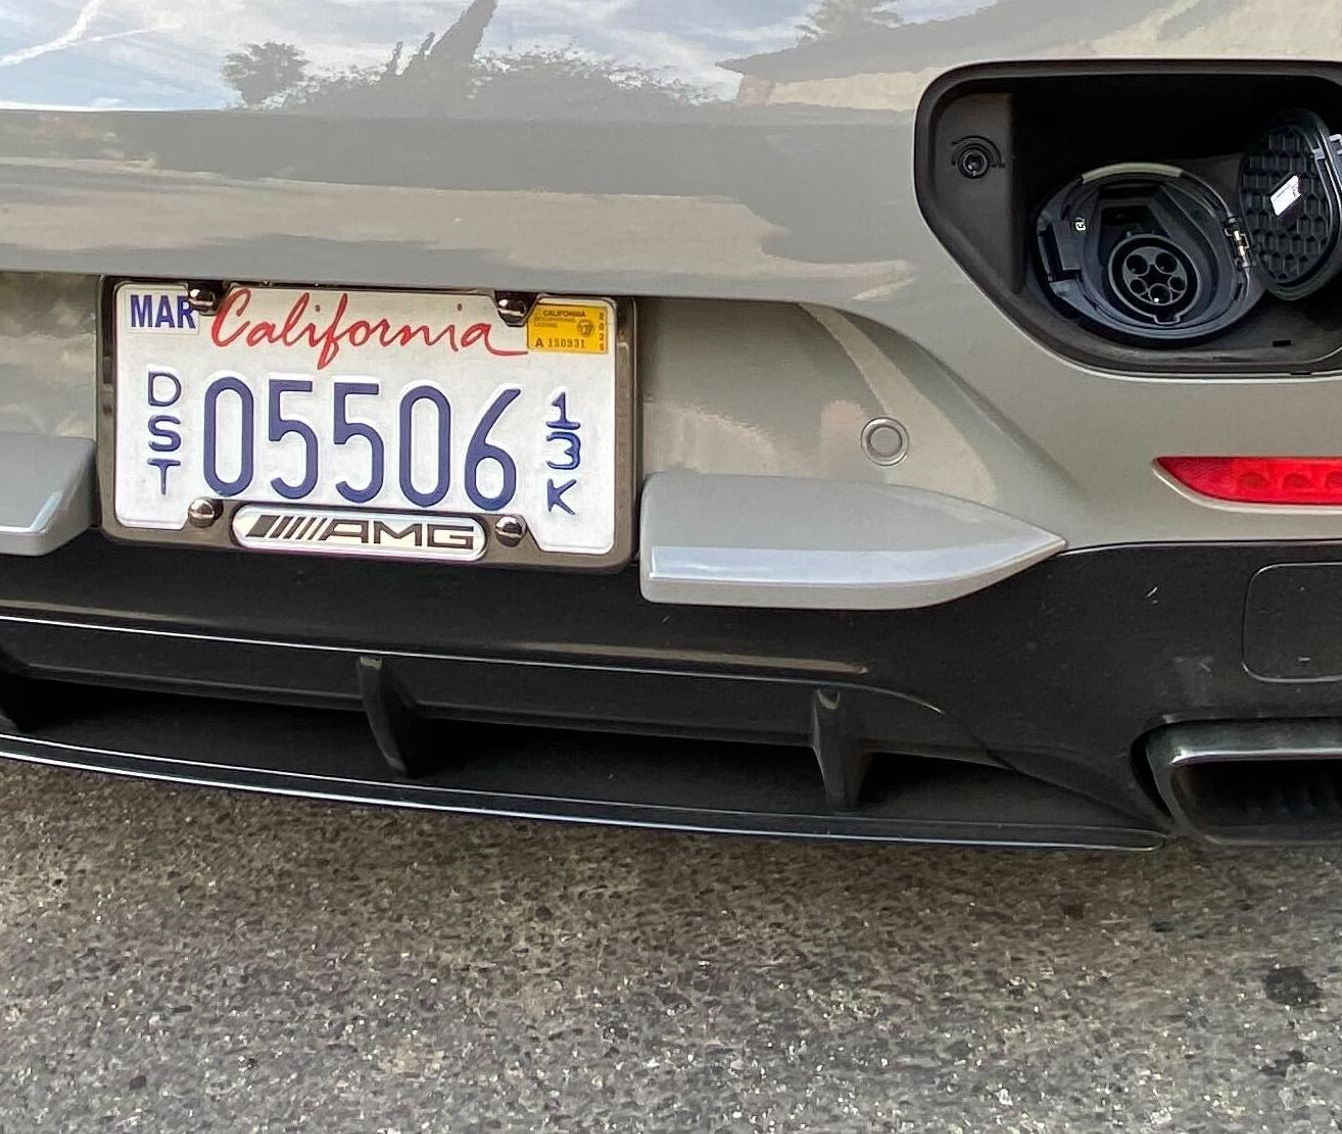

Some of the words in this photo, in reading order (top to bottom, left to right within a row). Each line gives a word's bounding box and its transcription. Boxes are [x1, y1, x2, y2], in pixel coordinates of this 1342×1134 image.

[130, 294, 196, 329] MAR
[211, 288, 529, 370] California
[535, 337, 544, 348] A
[203, 376, 521, 511] 05506
[317, 518, 474, 550] AMG
